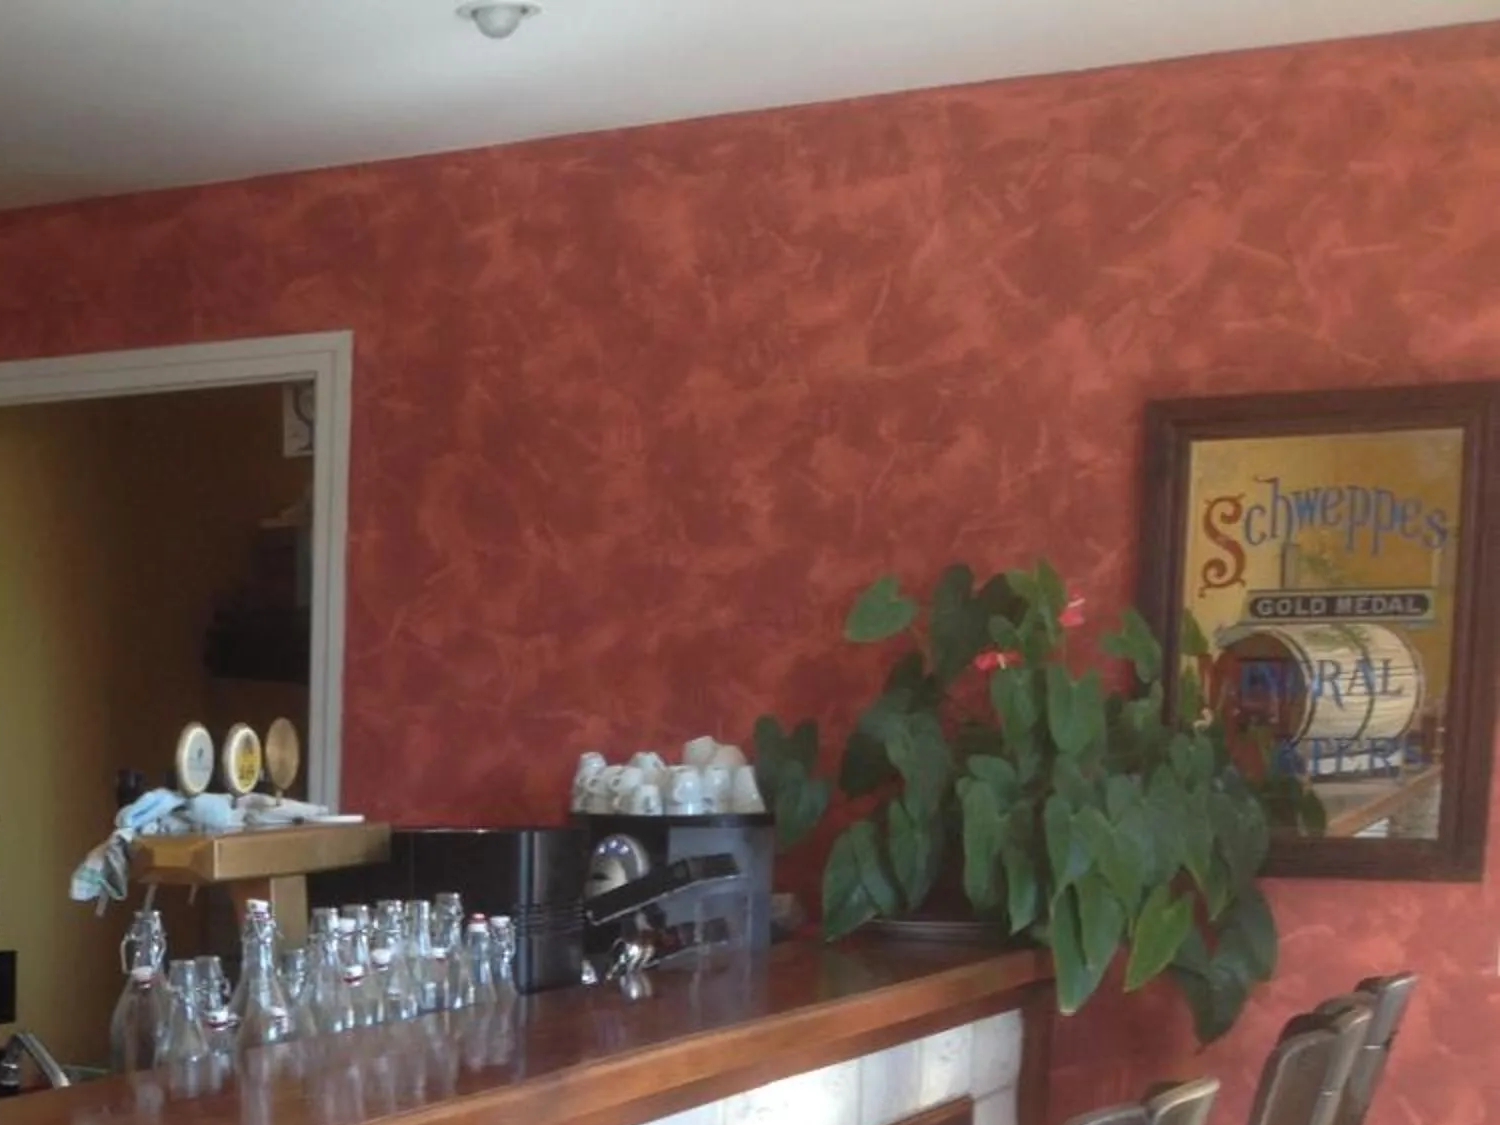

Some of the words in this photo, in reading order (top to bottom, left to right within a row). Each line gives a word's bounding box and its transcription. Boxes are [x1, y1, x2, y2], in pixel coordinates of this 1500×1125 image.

[1198, 476, 1449, 598] Schweppes
[1256, 599, 1327, 616] GOLD
[1334, 596, 1422, 616] MEDAL
